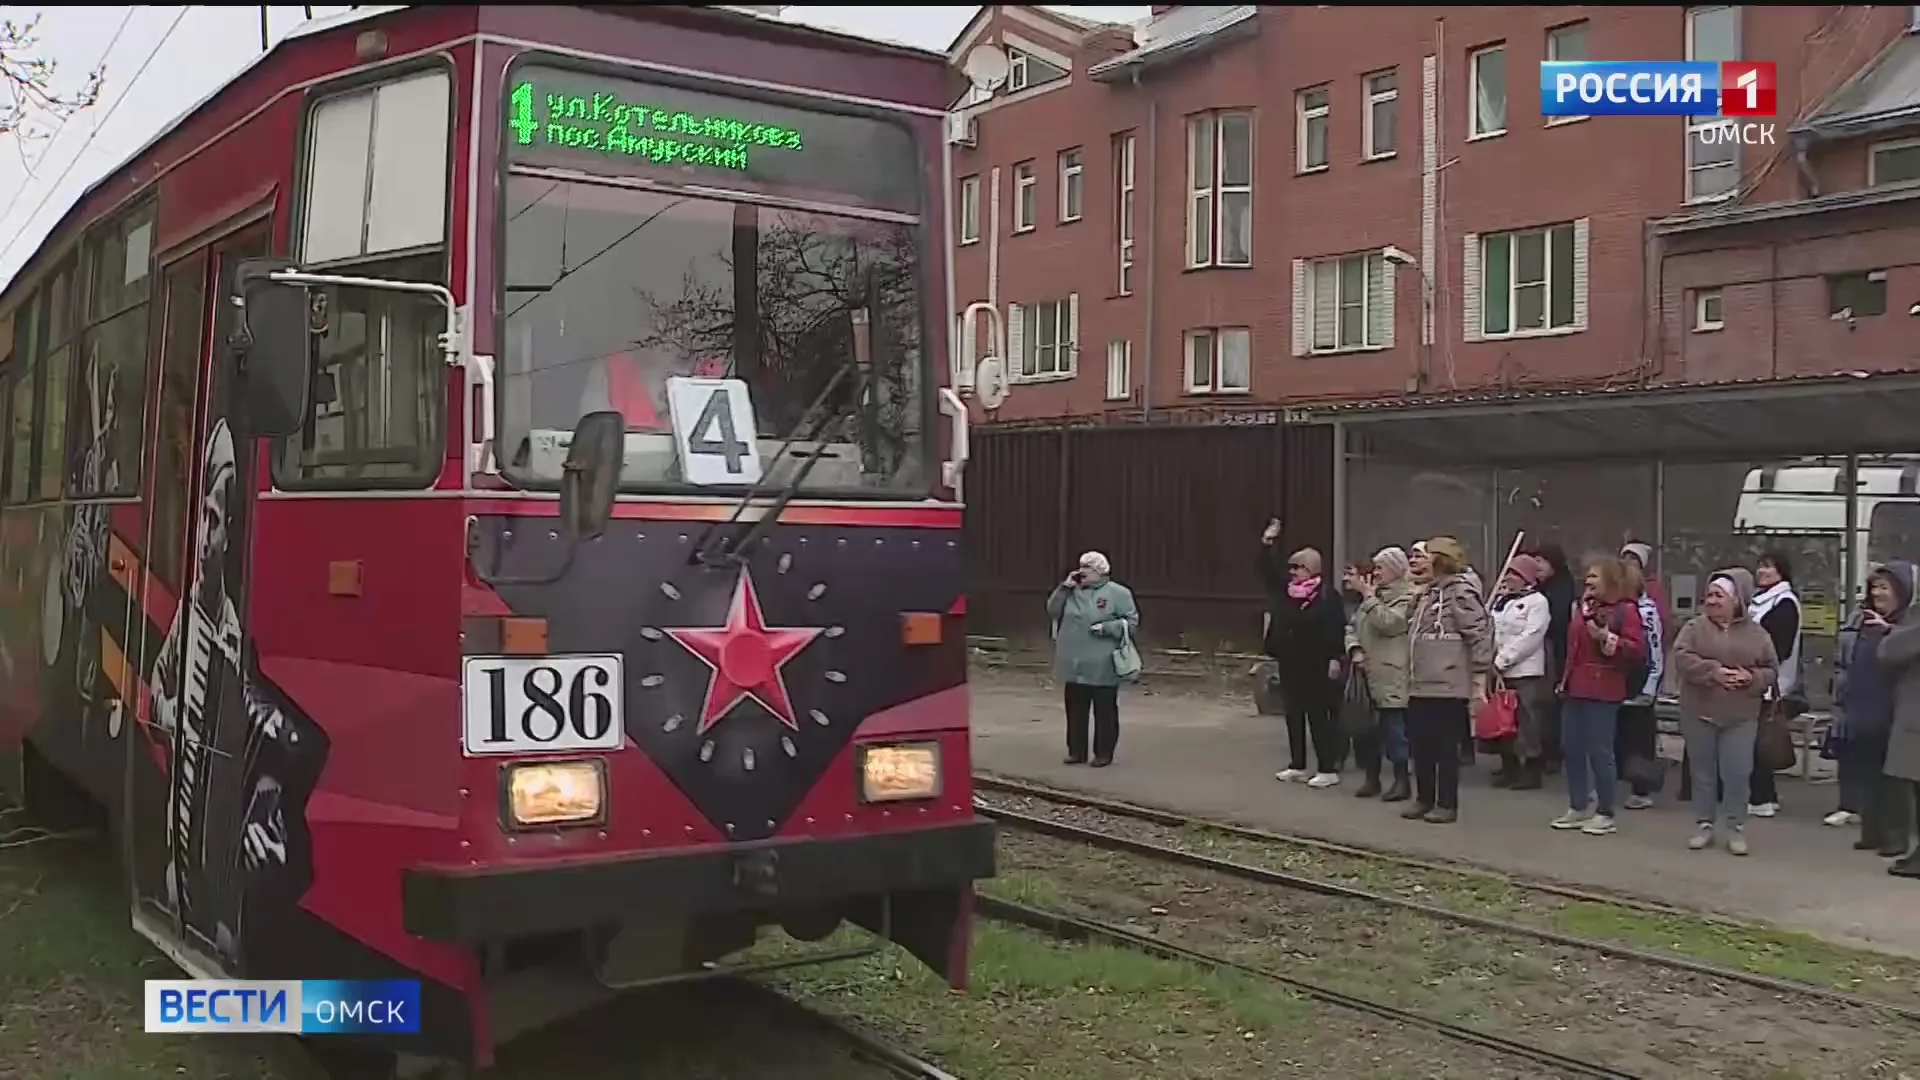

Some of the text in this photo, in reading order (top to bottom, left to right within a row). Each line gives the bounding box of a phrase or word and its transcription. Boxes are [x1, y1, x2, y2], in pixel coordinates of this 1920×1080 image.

[510, 82, 538, 144] 4
[547, 121, 748, 170] пос.Амурский
[688, 389, 750, 474] 4
[480, 665, 612, 742] 186
